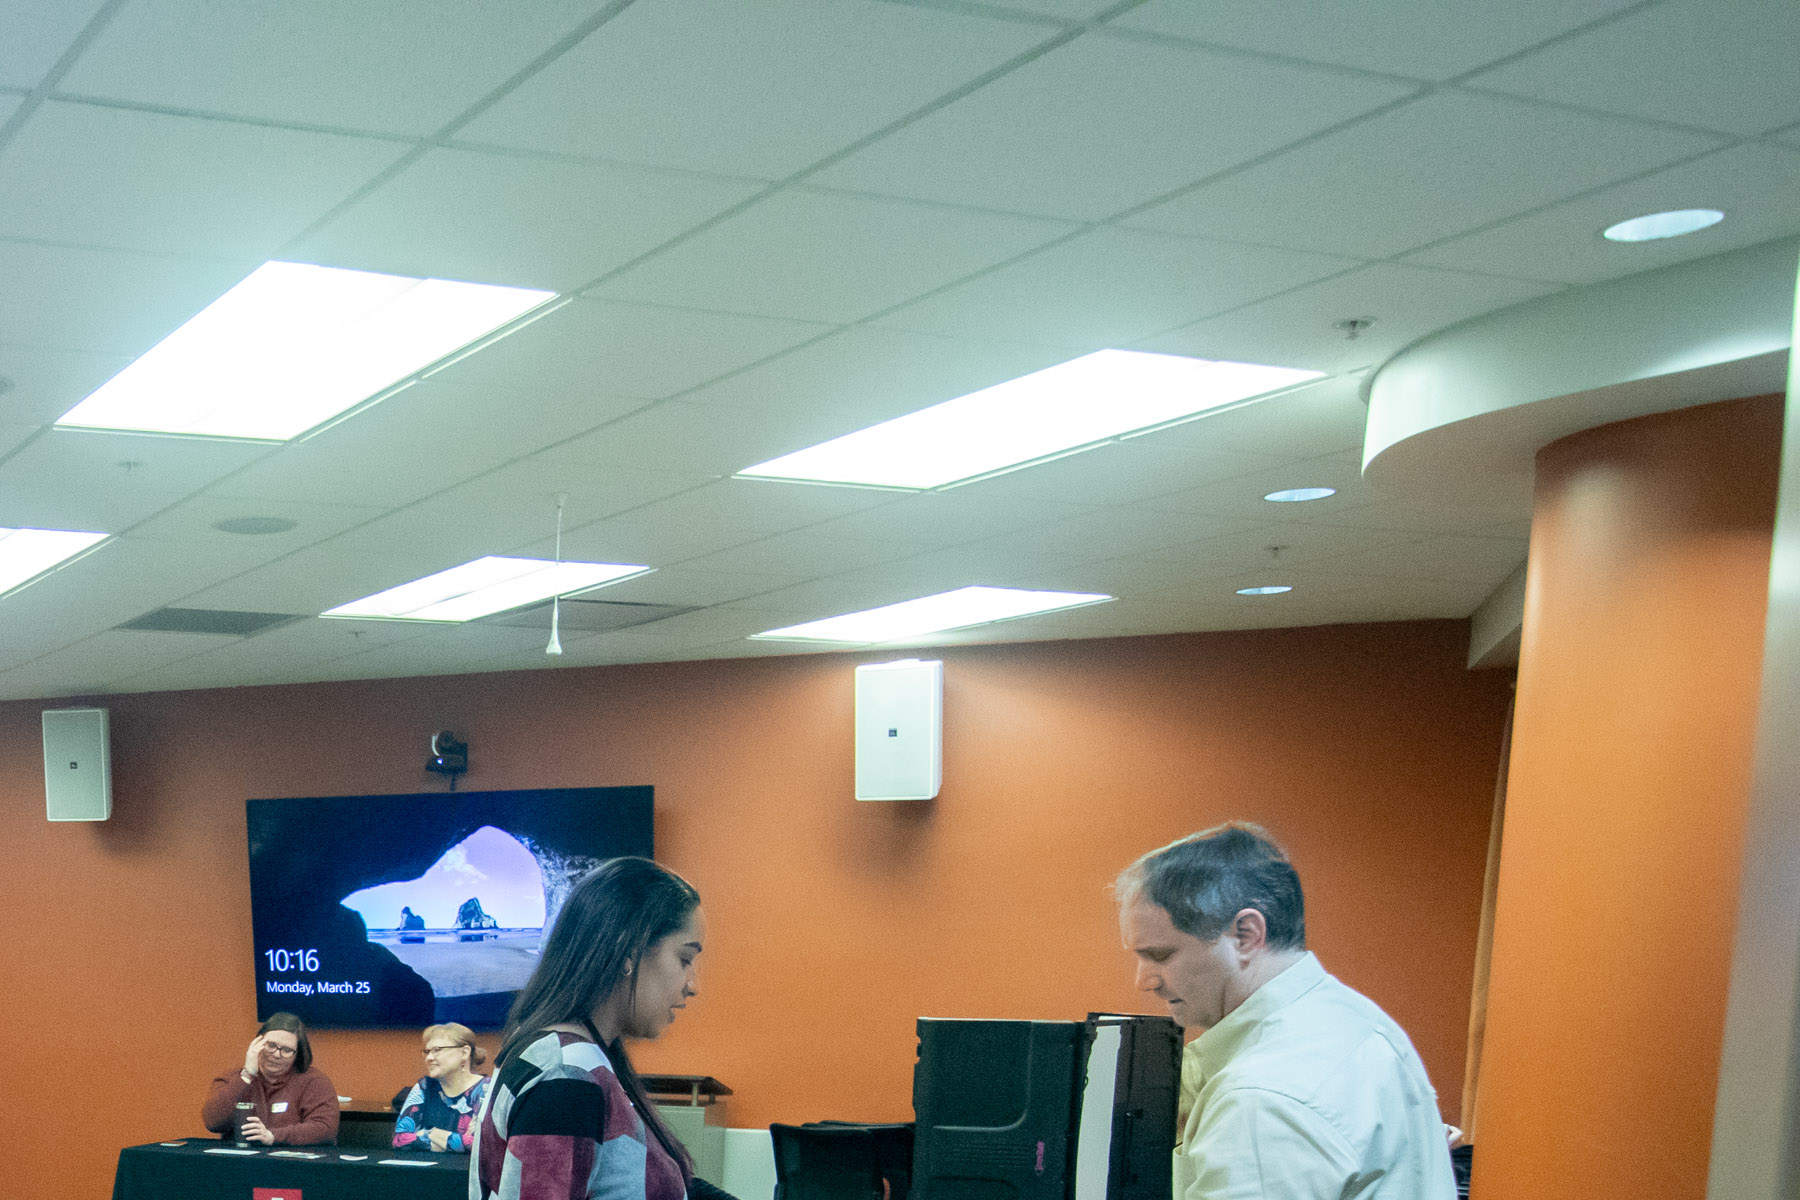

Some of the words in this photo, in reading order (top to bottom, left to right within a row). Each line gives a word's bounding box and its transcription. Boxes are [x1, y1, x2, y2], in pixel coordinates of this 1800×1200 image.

[264, 948, 320, 972] 10:16
[266, 981, 315, 996] Monday,
[317, 981, 353, 994] March
[355, 981, 371, 994] 25
